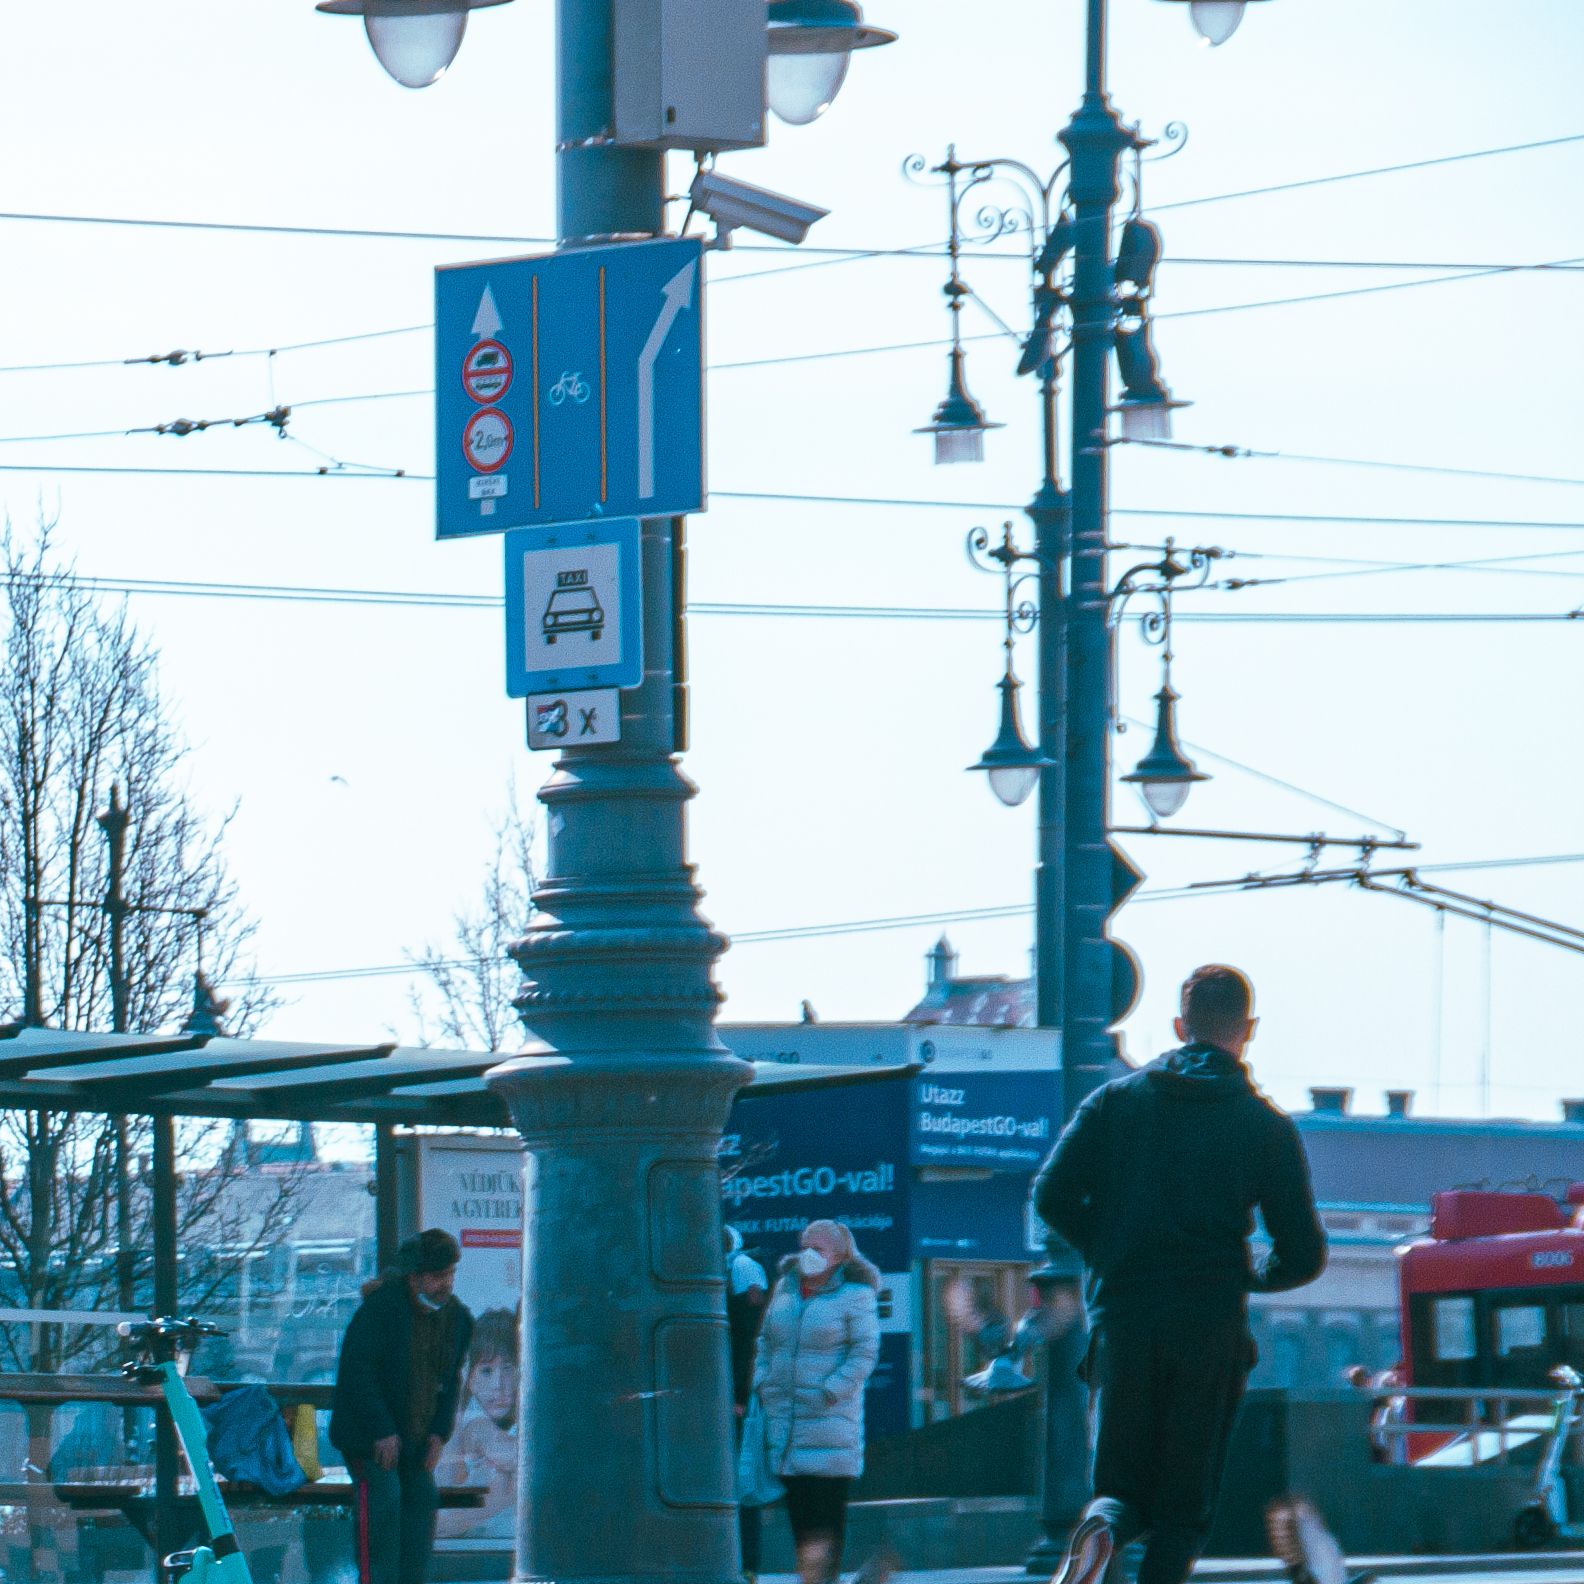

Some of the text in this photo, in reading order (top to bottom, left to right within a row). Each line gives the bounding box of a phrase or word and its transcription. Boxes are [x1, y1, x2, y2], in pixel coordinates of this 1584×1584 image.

[561, 573, 587, 583] TAXI
[921, 1084, 965, 1105] Utazz
[921, 1112, 1049, 1138] BudapestGO-val!
